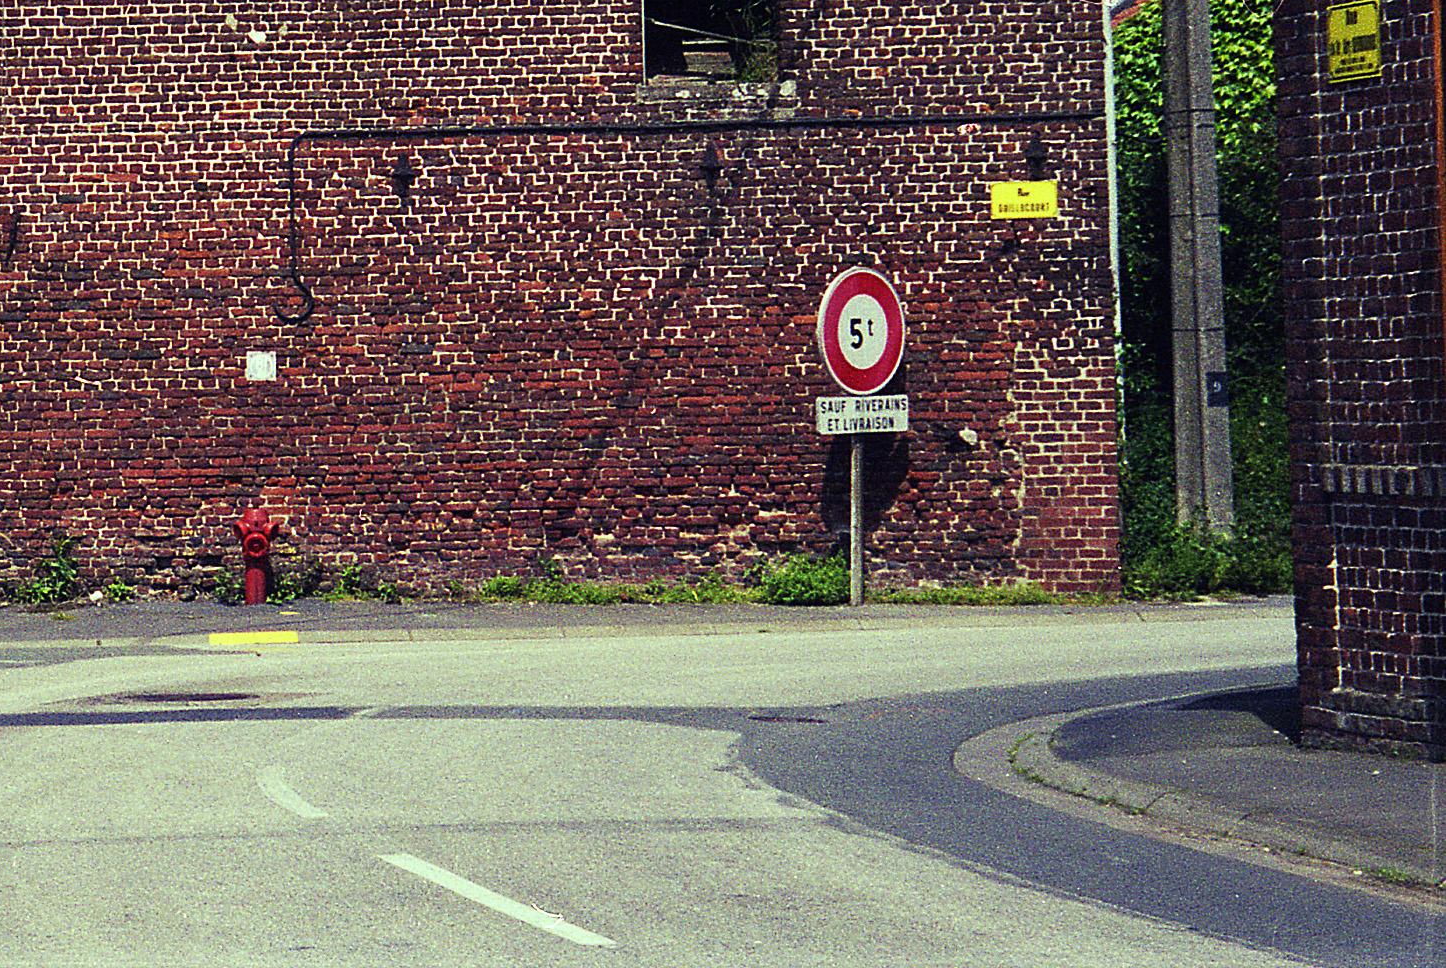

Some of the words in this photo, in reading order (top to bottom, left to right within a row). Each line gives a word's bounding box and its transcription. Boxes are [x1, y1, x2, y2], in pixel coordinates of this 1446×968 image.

[820, 400, 847, 414] SAUF
[854, 398, 907, 412] RIVERAINS
[827, 418, 840, 432] ET
[843, 416, 895, 431] LIVRAISON
